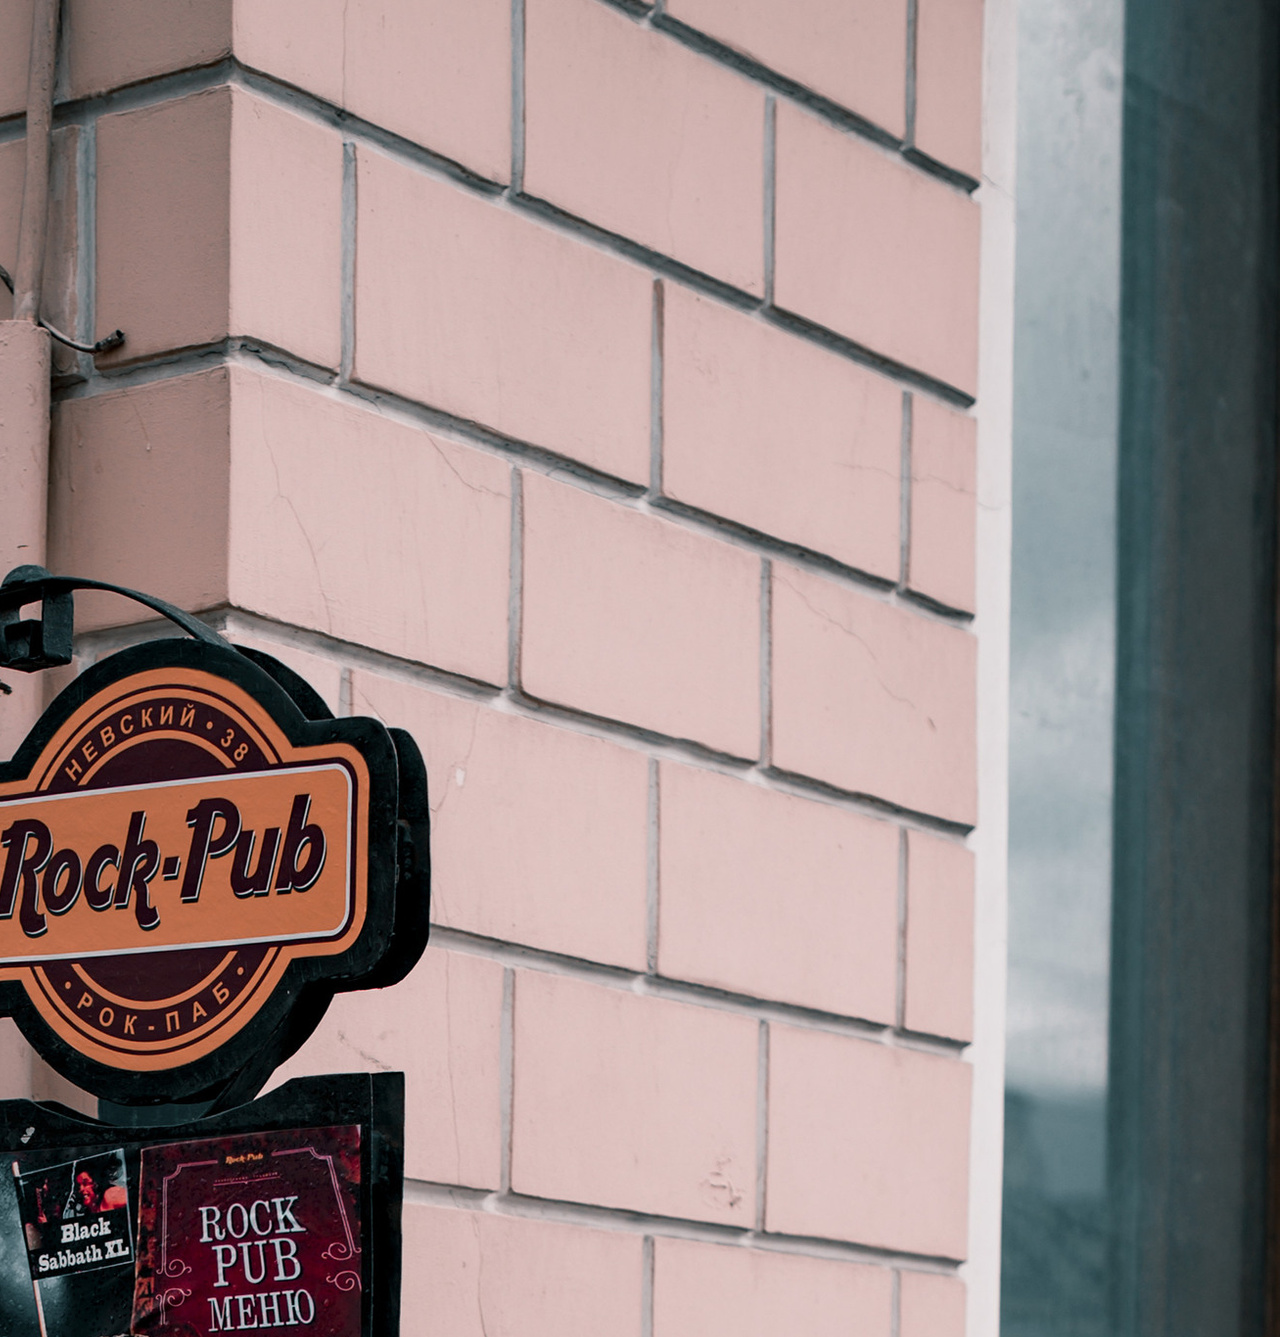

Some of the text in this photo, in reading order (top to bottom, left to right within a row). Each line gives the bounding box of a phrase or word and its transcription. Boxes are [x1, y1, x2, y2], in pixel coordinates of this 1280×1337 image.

[65, 703, 249, 782] НЕВСКИЙ 38
[77, 983, 231, 1036] РОК-ПАБ
[60, 1216, 112, 1244] Black
[198, 1195, 307, 1243] ROCK
[38, 1238, 130, 1273] Sabbath XL
[211, 1237, 302, 1288] PUB
[206, 1288, 316, 1333] МЕНЮ
